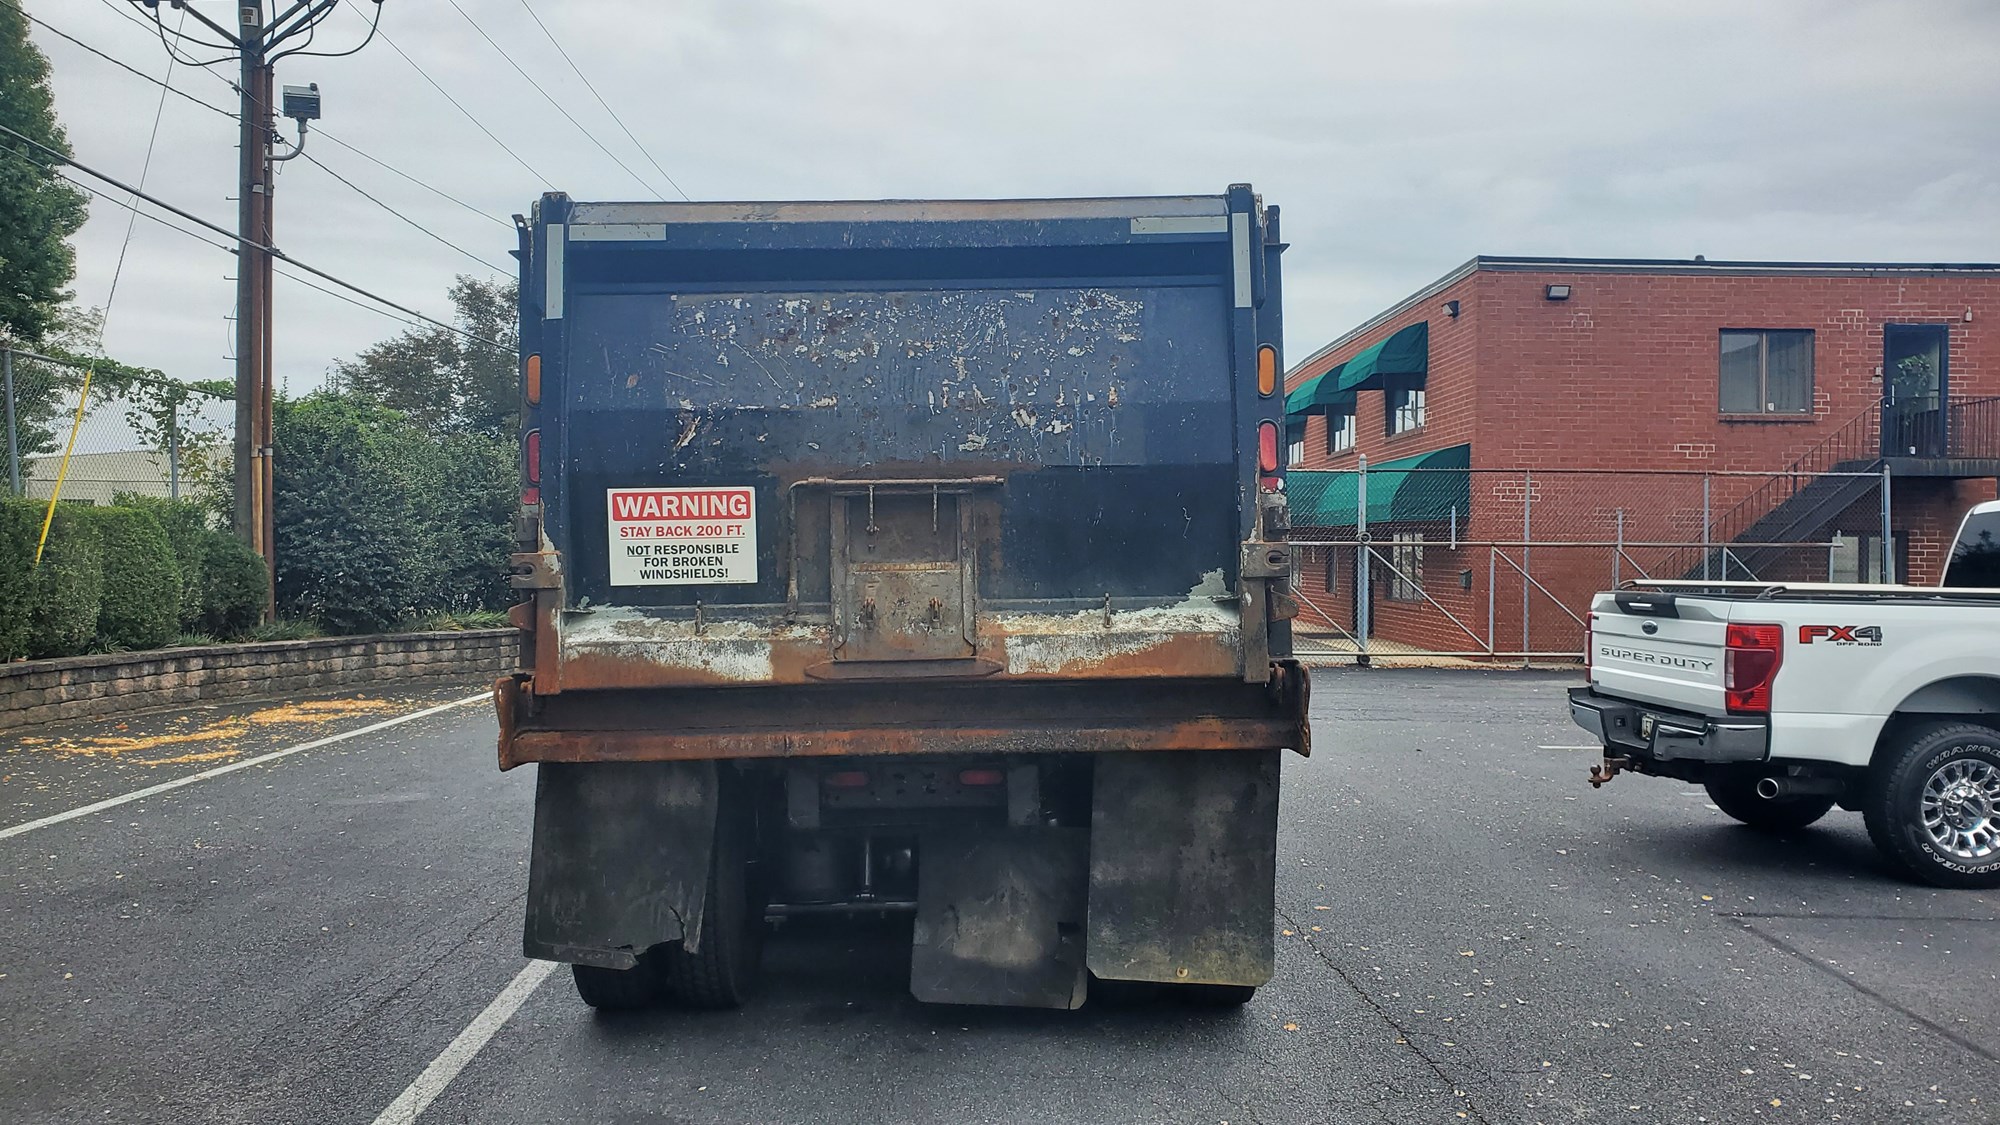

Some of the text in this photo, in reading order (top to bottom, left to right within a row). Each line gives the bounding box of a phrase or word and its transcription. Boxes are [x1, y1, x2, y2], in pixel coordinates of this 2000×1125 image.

[616, 494, 748, 518] WARNING
[620, 525, 746, 538] STAY BACK 200 FT.
[627, 544, 739, 556] NOT RESPONSIBLE
[644, 556, 723, 567] FOR BROKEN
[639, 568, 729, 580] WINDSHIELDS!
[1799, 625, 1883, 645] FX4
[1601, 647, 1713, 670] SUPER DUTY
